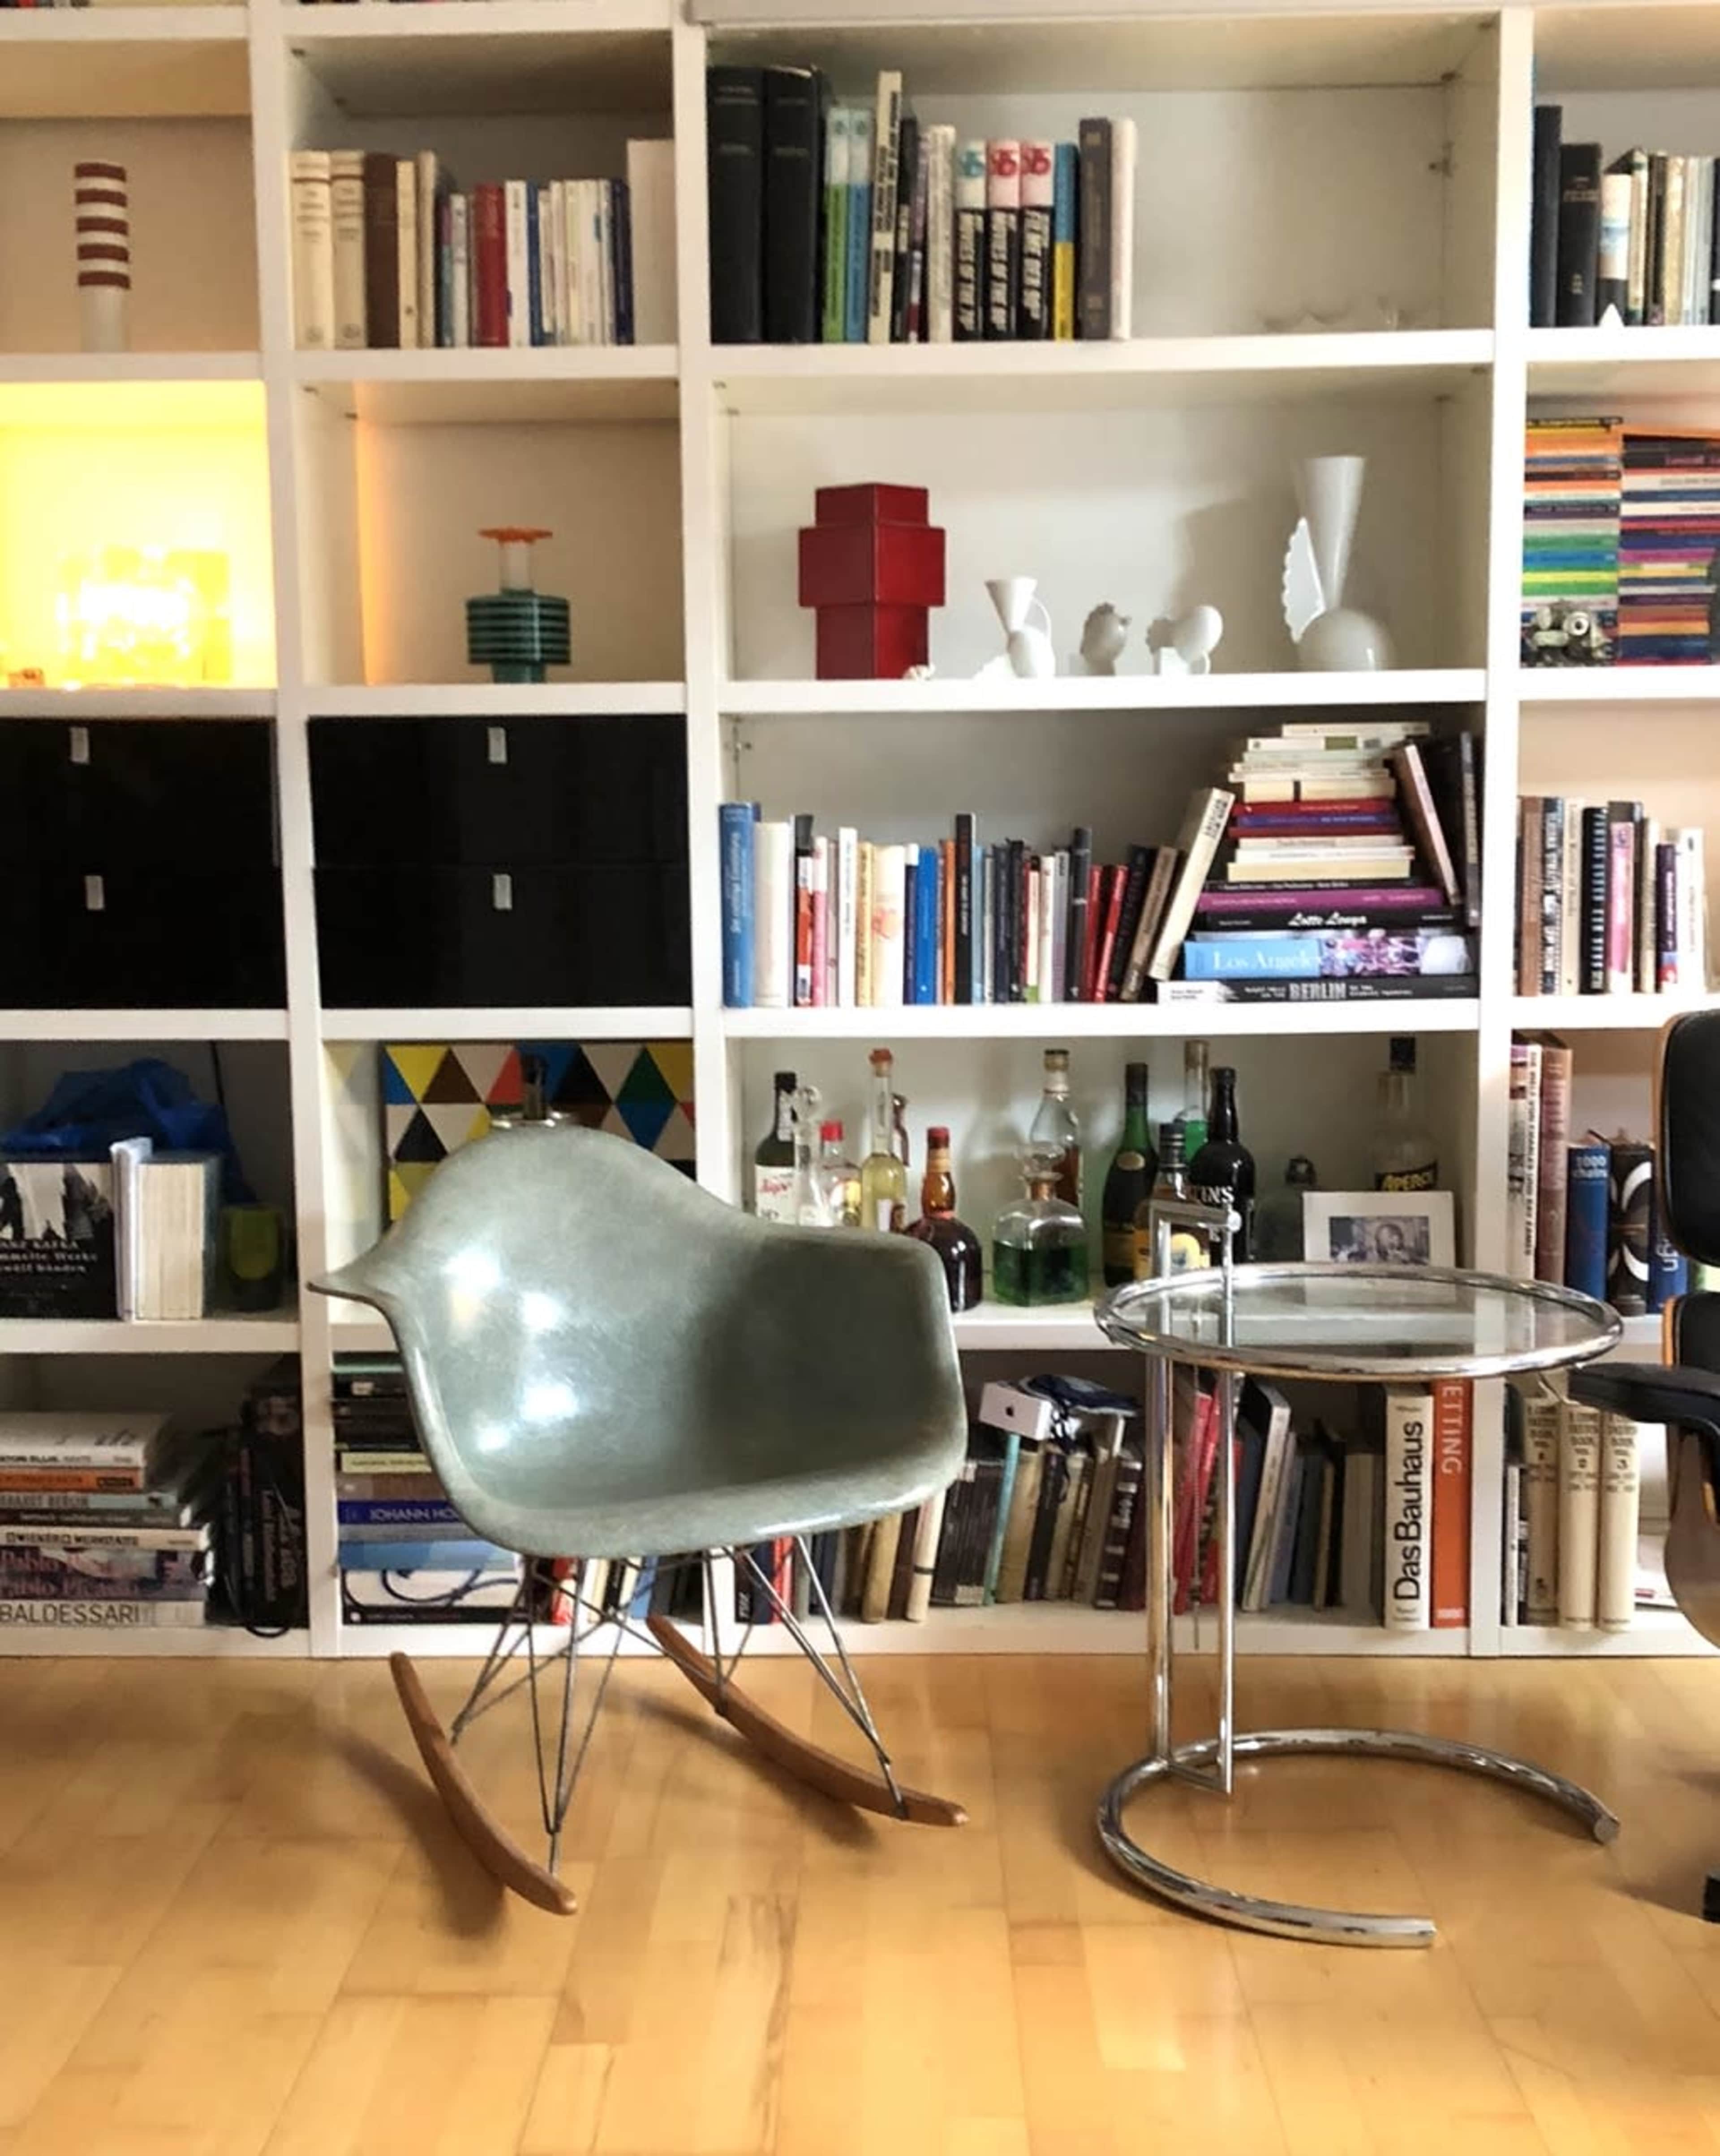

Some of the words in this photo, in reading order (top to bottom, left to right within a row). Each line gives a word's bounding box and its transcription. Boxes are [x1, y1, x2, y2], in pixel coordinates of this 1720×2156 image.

[1214, 951, 1249, 971] Los
[1256, 950, 1323, 972] Angeles
[1289, 983, 1346, 1000] BERLIN
[33, 1240, 79, 1250] KAFKA
[1442, 1381, 1464, 1474] ETTING
[1617, 1459, 1628, 1469] 3
[1394, 1421, 1424, 1542] Bauhaus
[369, 1508, 430, 1521] JOHANN
[1394, 1545, 1421, 1600] Das
[0, 1603, 140, 1623] BALDESSARI
